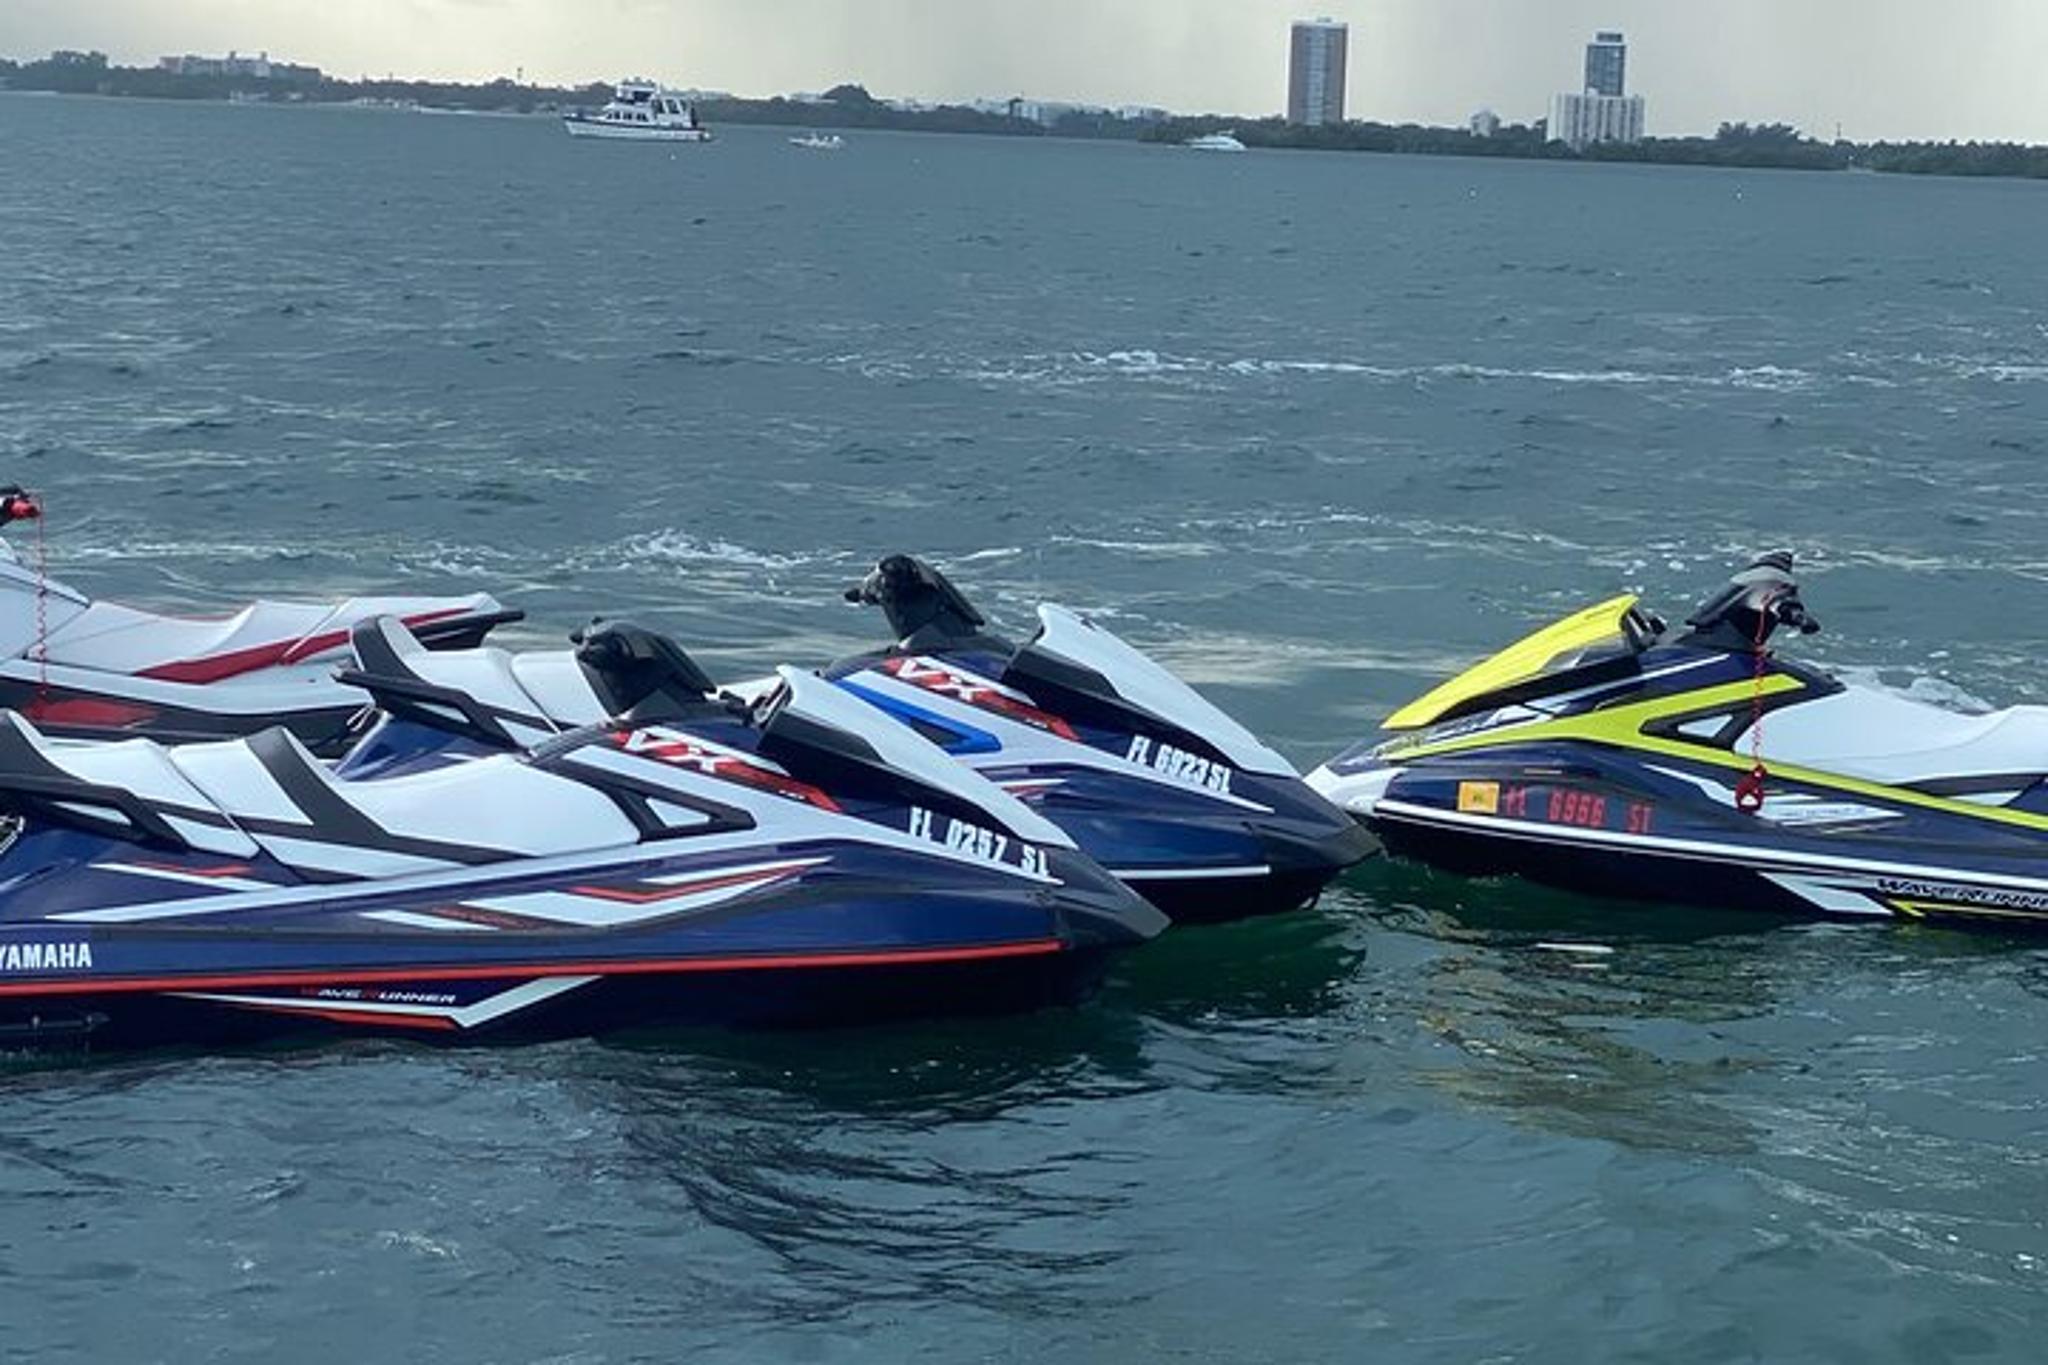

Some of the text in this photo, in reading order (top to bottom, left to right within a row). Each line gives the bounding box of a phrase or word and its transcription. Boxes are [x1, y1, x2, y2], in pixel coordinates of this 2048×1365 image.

[1126, 734, 1232, 793] FL 6923 SL
[909, 806, 1049, 876] FL 0257 SL
